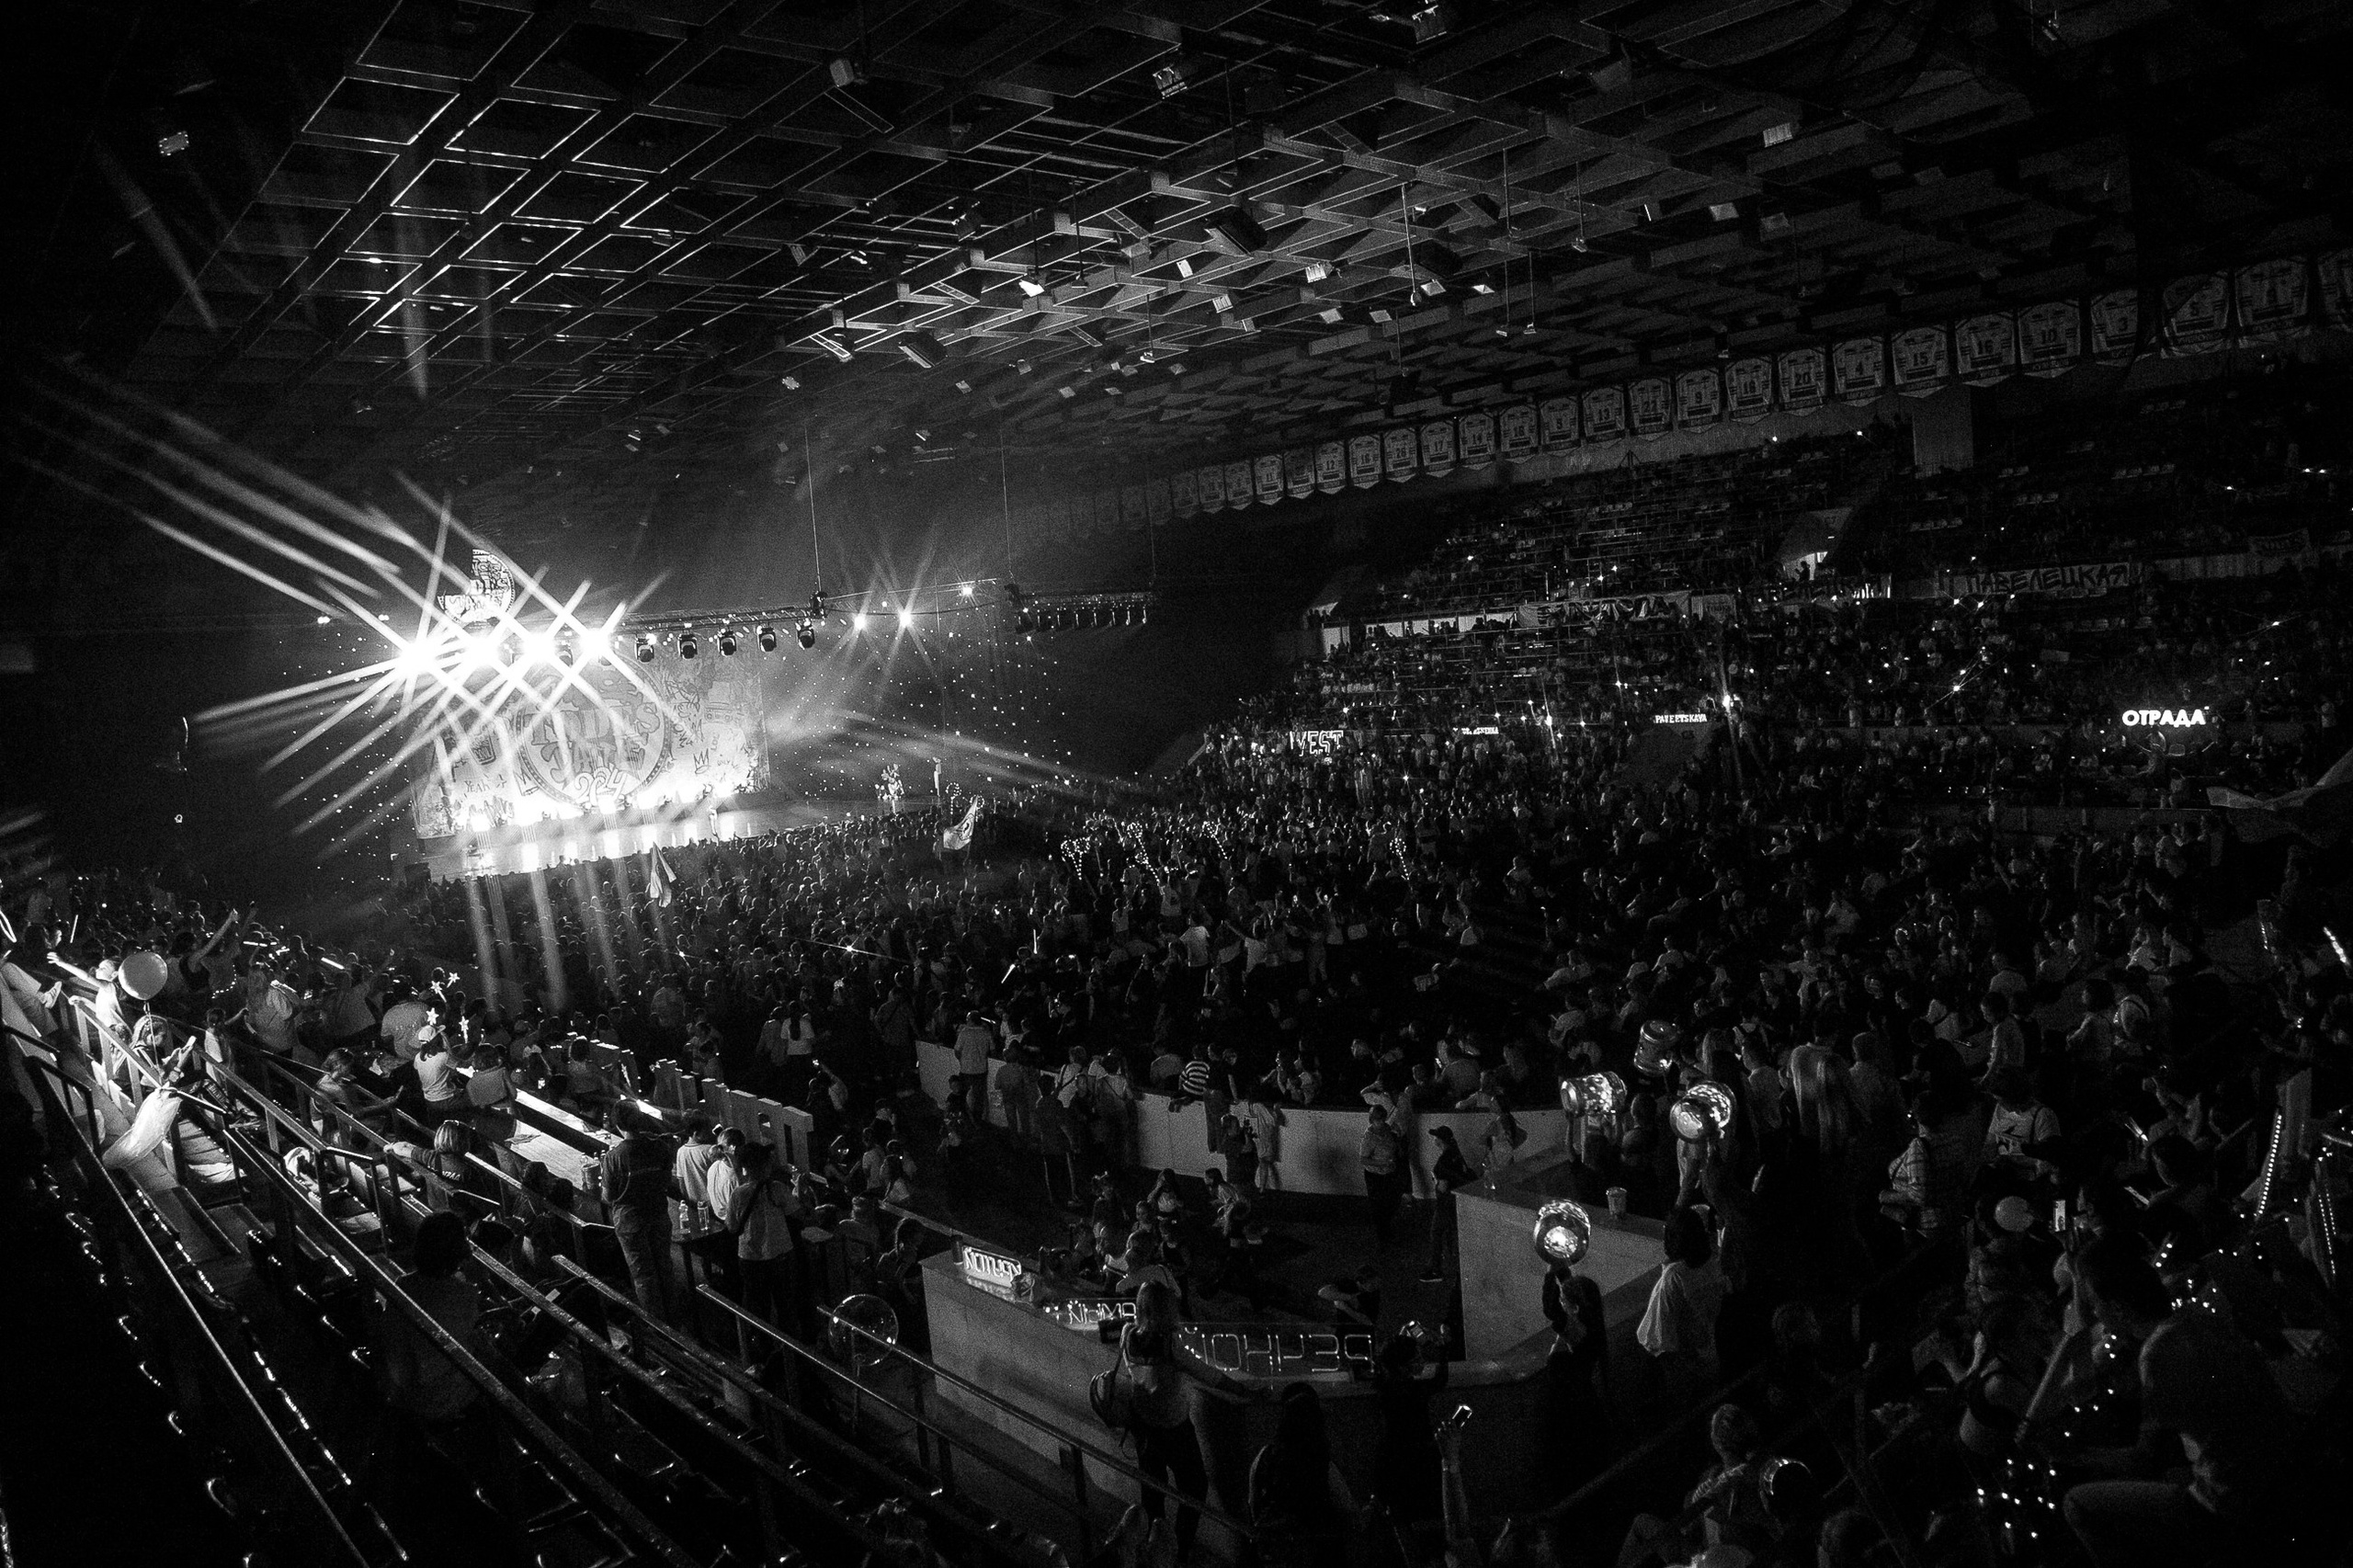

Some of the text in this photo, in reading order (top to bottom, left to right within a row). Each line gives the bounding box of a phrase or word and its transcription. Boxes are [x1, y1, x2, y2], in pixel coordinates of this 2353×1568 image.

[2119, 317, 2129, 333] 3
[2040, 329, 2058, 344] 10
[1913, 352, 1928, 367] 15
[1855, 361, 1864, 376] 4
[1795, 372, 1811, 387] 20
[1597, 409, 1610, 421] 13
[1966, 564, 2127, 594] ПАВЕЛЕЦКАЯ
[2121, 709, 2207, 728] ОТРАДА
[1289, 729, 1344, 757] WEST
